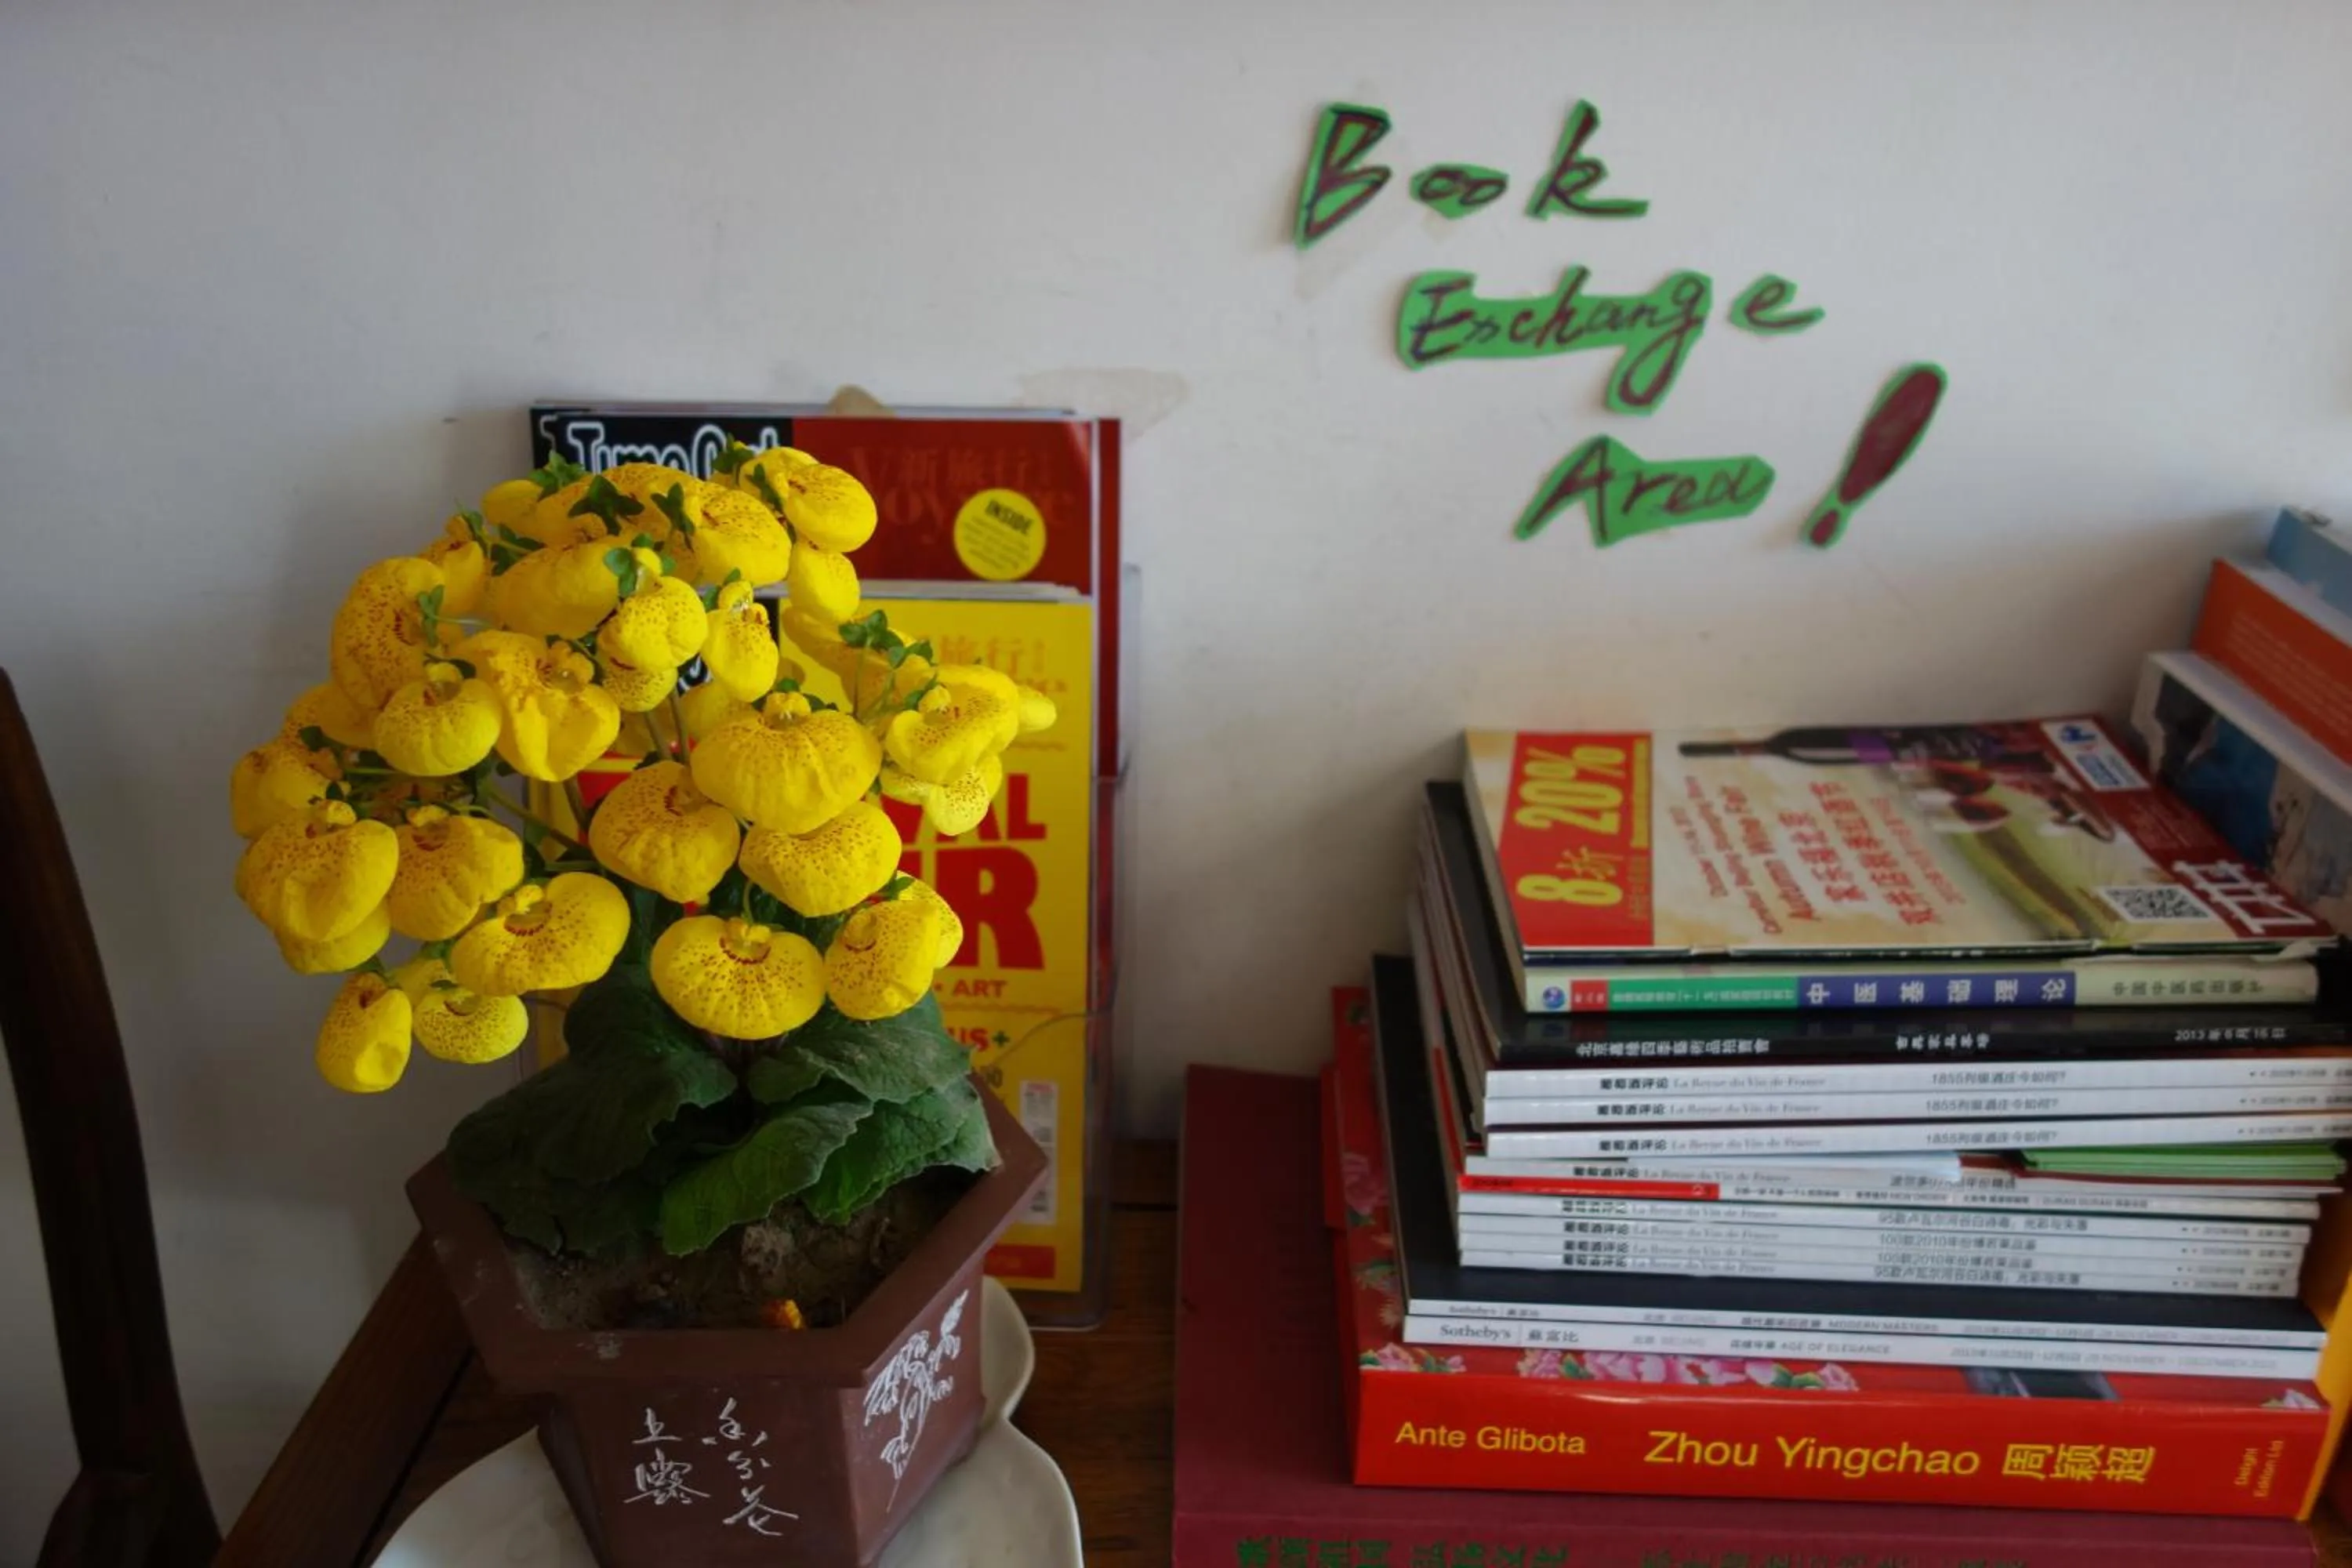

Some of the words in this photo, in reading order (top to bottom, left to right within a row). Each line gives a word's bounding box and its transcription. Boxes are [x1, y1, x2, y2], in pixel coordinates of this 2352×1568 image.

[1301, 105, 1648, 246] Book
[1515, 744, 1627, 835] 20%
[953, 980, 1007, 997] ART
[1806, 978, 2067, 1004] 中医基础理论
[1600, 1078, 1668, 1090] 葡萄酒评论
[1597, 1104, 1665, 1116] 葡萄酒评论
[1599, 1140, 1668, 1152] 葡萄酒评论
[1440, 1324, 1512, 1341] Sotheby's
[1396, 1421, 1467, 1448] Ante
[1476, 1425, 1586, 1455] Glibota
[1643, 1431, 1759, 1467] Zhou
[1776, 1436, 1980, 1479] Yingchao
[2002, 1443, 2156, 1484] 周颖超
